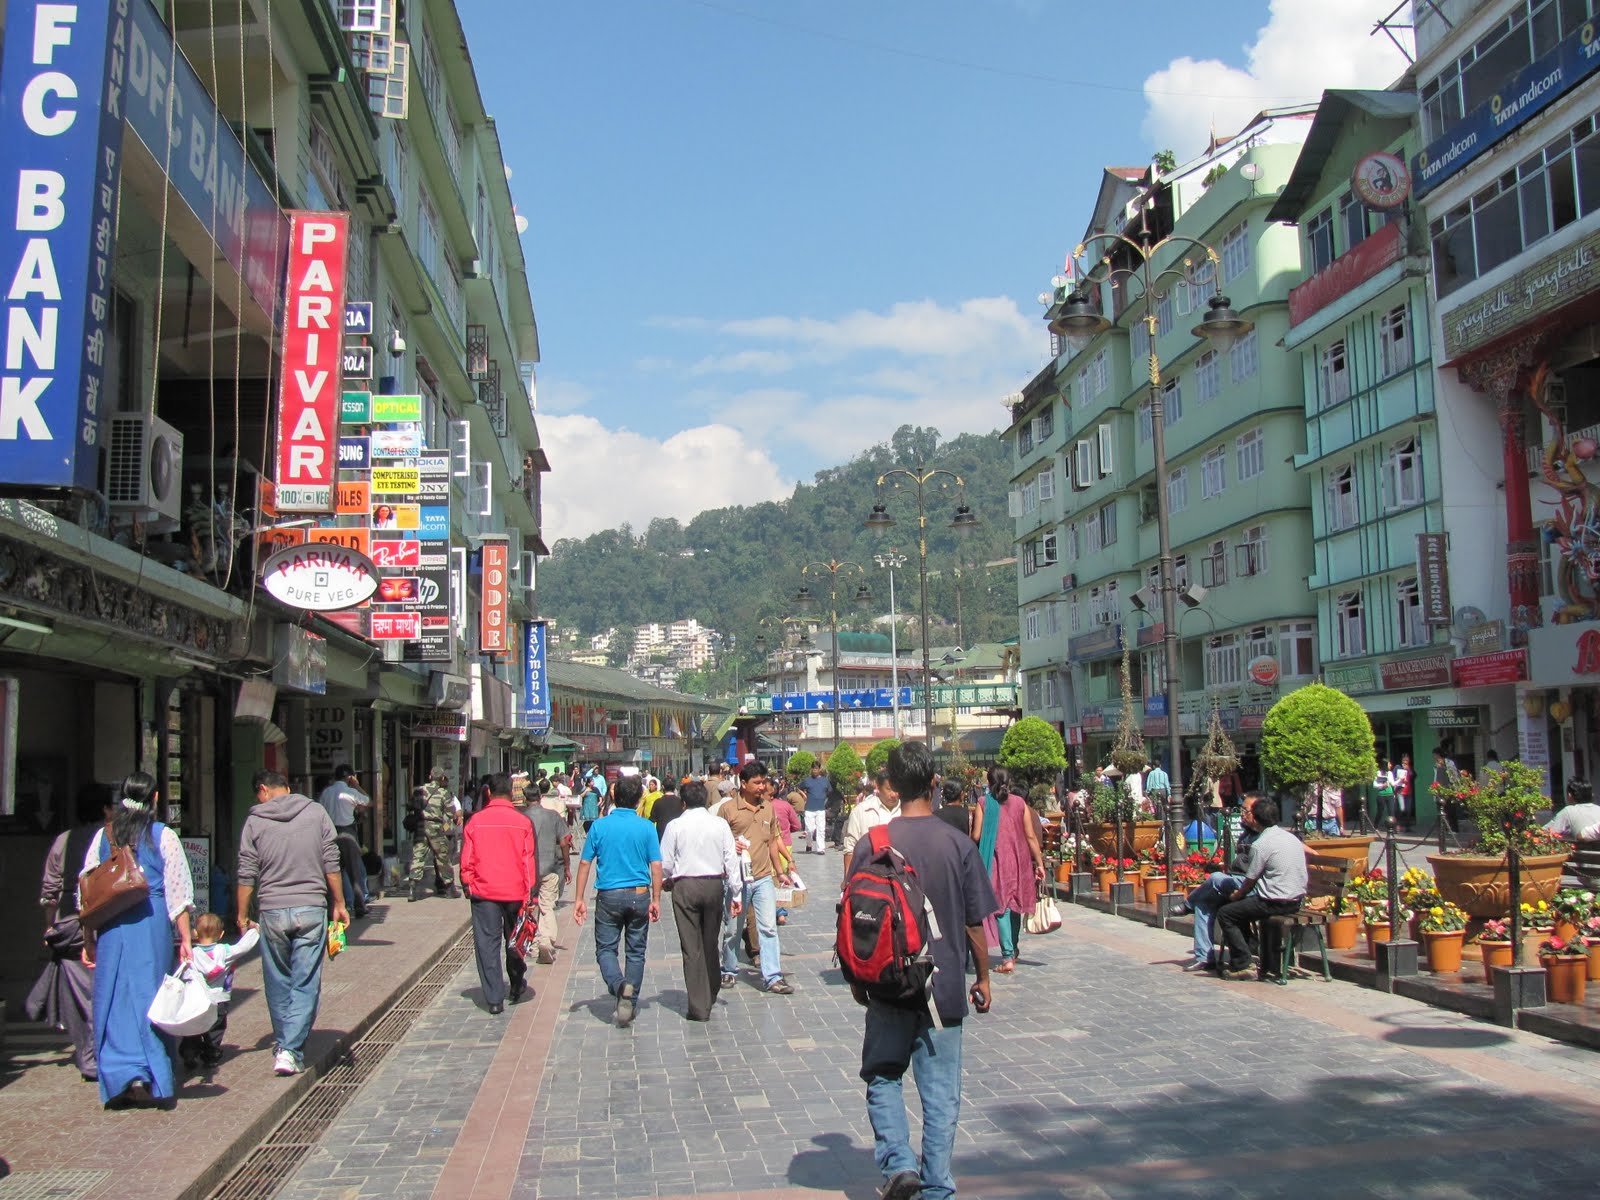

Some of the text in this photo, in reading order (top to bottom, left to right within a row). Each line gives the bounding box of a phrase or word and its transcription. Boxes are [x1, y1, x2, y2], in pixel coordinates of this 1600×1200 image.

[1494, 68, 1562, 127] TATA indicom
[1422, 131, 1477, 180] TATA indicom
[189, 112, 251, 236] BANK
[0, 4, 78, 441] FC BANK
[289, 223, 336, 479] PARIVAR
[375, 402, 420, 413] OPTICAL
[373, 448, 419, 456] CONTACT LENSES
[373, 471, 418, 479] COMPUTERISED
[278, 551, 369, 582] PARIVAR
[371, 541, 417, 566] Ray-Ban
[286, 586, 320, 603] PURE
[488, 549, 502, 647] LODGE
[1406, 695, 1431, 707] LODGING
[183, 841, 208, 857] TRAVELS
